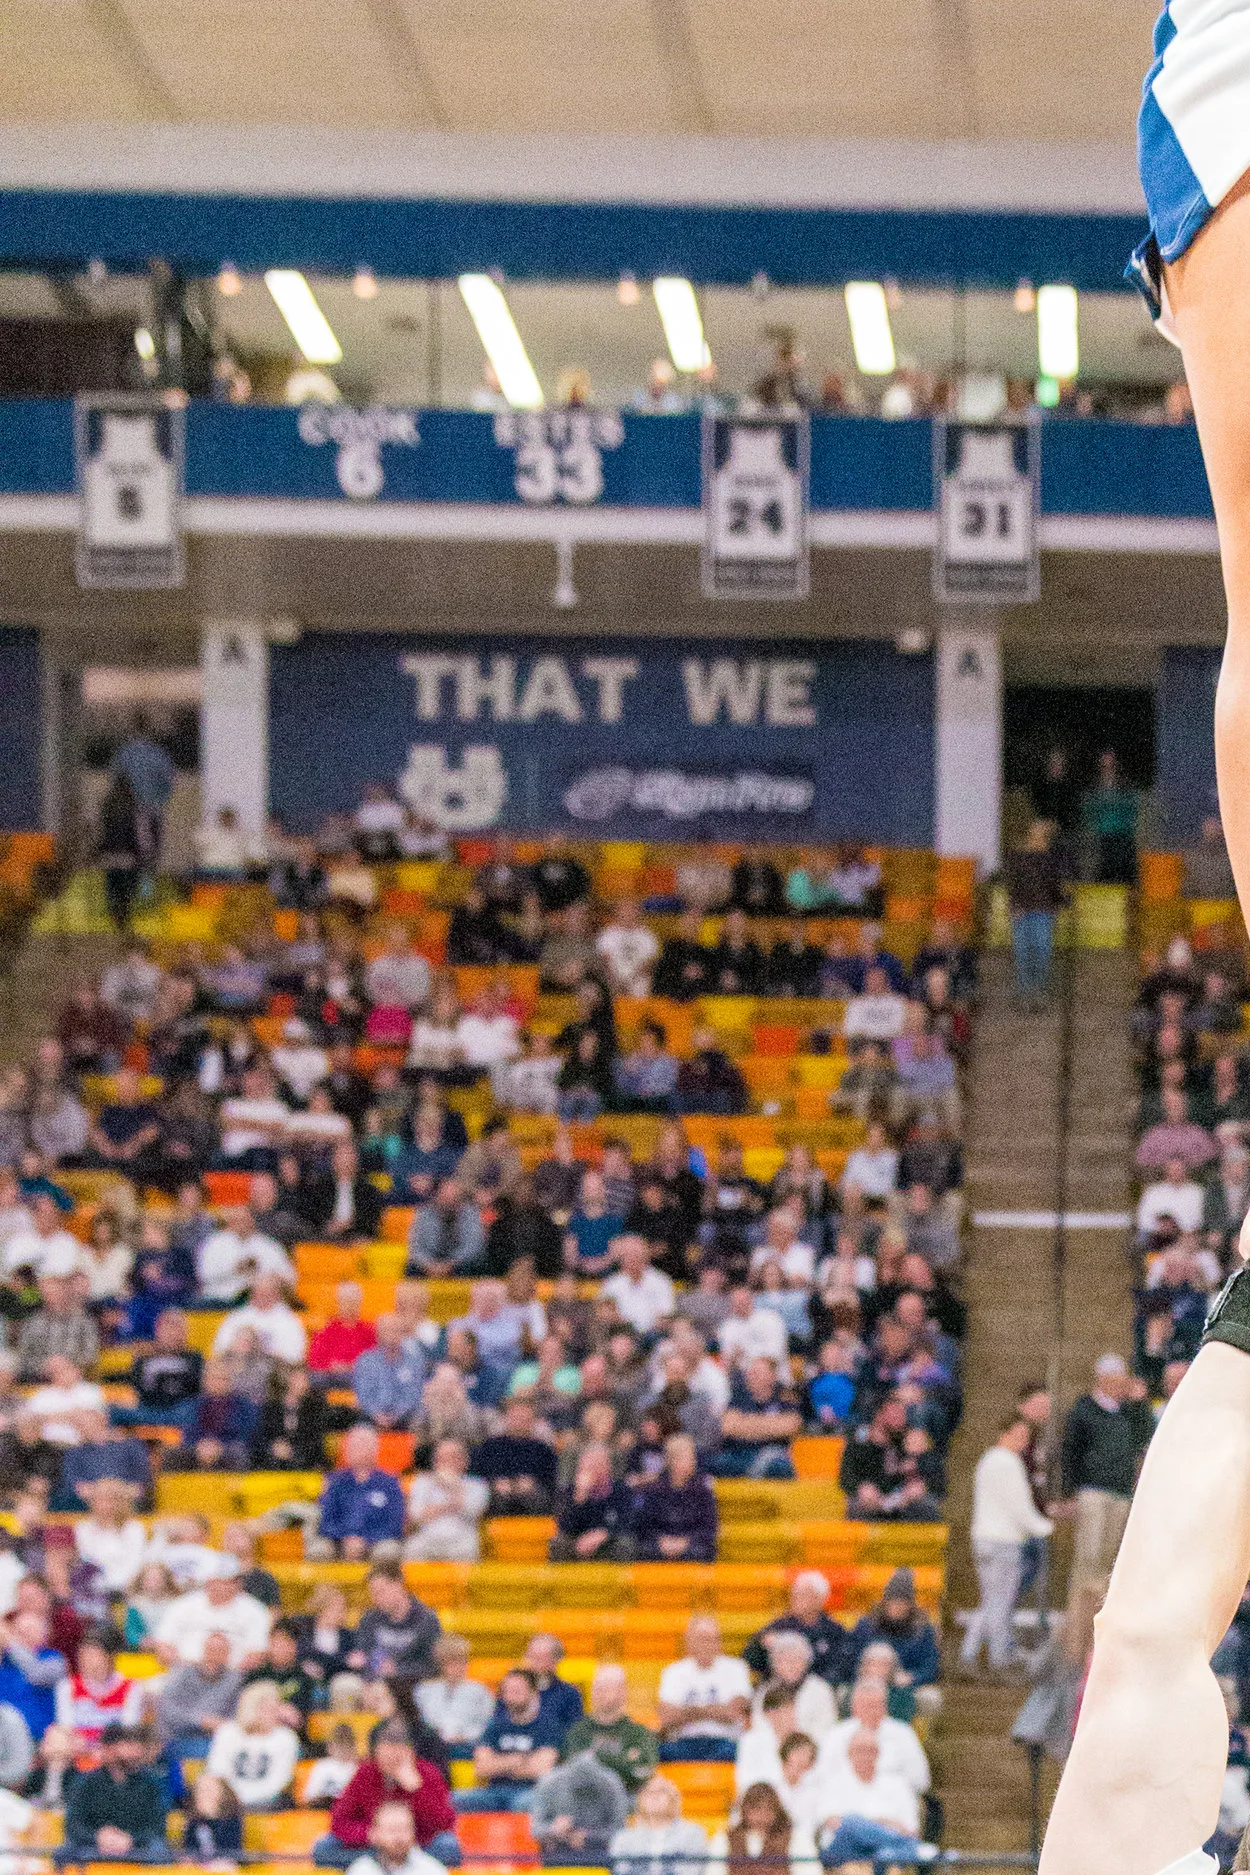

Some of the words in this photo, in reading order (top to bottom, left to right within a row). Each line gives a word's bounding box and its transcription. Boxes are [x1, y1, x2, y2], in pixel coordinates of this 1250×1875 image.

[514, 444, 605, 503] 33
[403, 654, 638, 724] THAT
[682, 657, 819, 728] WE
